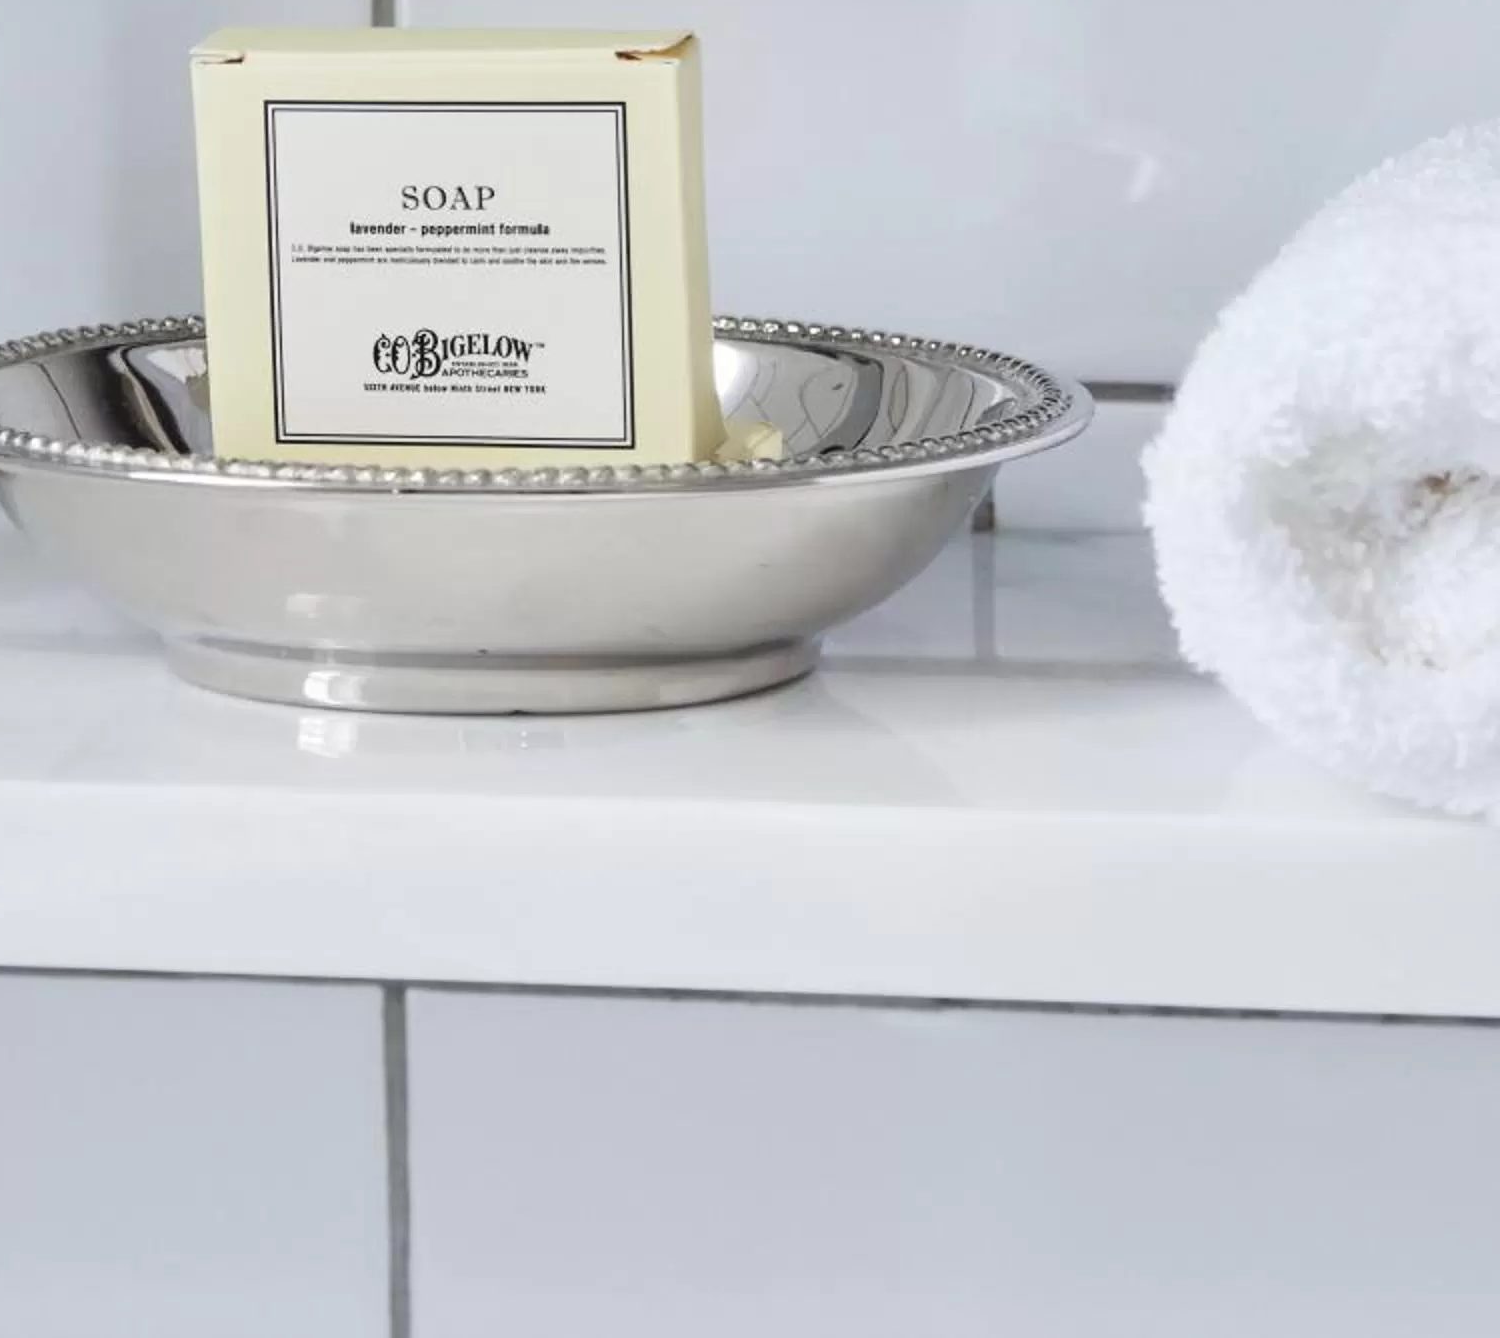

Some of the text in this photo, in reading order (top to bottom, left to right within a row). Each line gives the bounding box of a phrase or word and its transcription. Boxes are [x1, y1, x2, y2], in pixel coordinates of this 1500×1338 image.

[402, 186, 495, 211] SOAP
[350, 221, 550, 238] lavender peppermint formula
[441, 369, 528, 378] APOTHECARIES
[390, 383, 420, 392] AVENUE
[476, 385, 500, 393] Street
[503, 385, 521, 393] NEW
[525, 385, 546, 393] YORK
